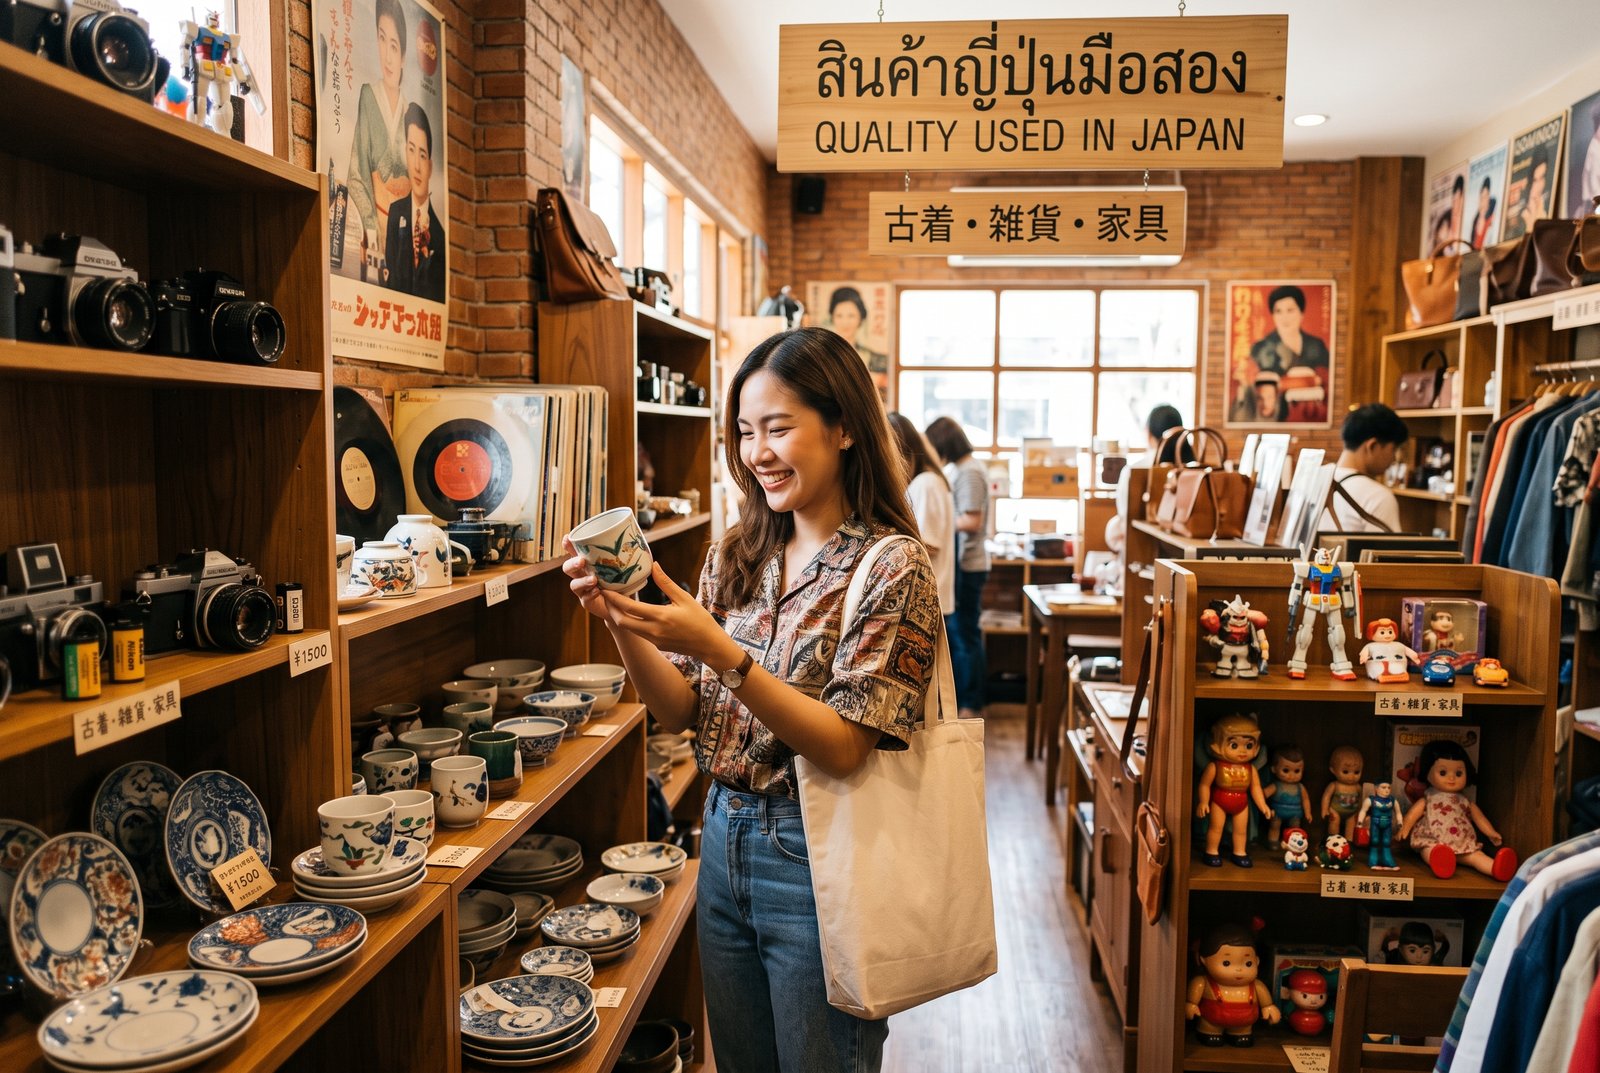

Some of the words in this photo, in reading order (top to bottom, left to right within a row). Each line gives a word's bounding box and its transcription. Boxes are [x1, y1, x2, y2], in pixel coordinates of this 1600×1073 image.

[817, 21, 1247, 117] สินค้าญี่ปุ่นมือสอง
[815, 120, 958, 154] QUALITY
[975, 119, 1064, 153] USED
[1083, 118, 1115, 151] IN
[1131, 117, 1245, 152] JAPAN
[884, 203, 1169, 243] 古着・雑貨・家具
[127, 640, 135, 671] Nikon
[294, 644, 328, 667] ¥1500
[226, 868, 261, 895] ¥1500
